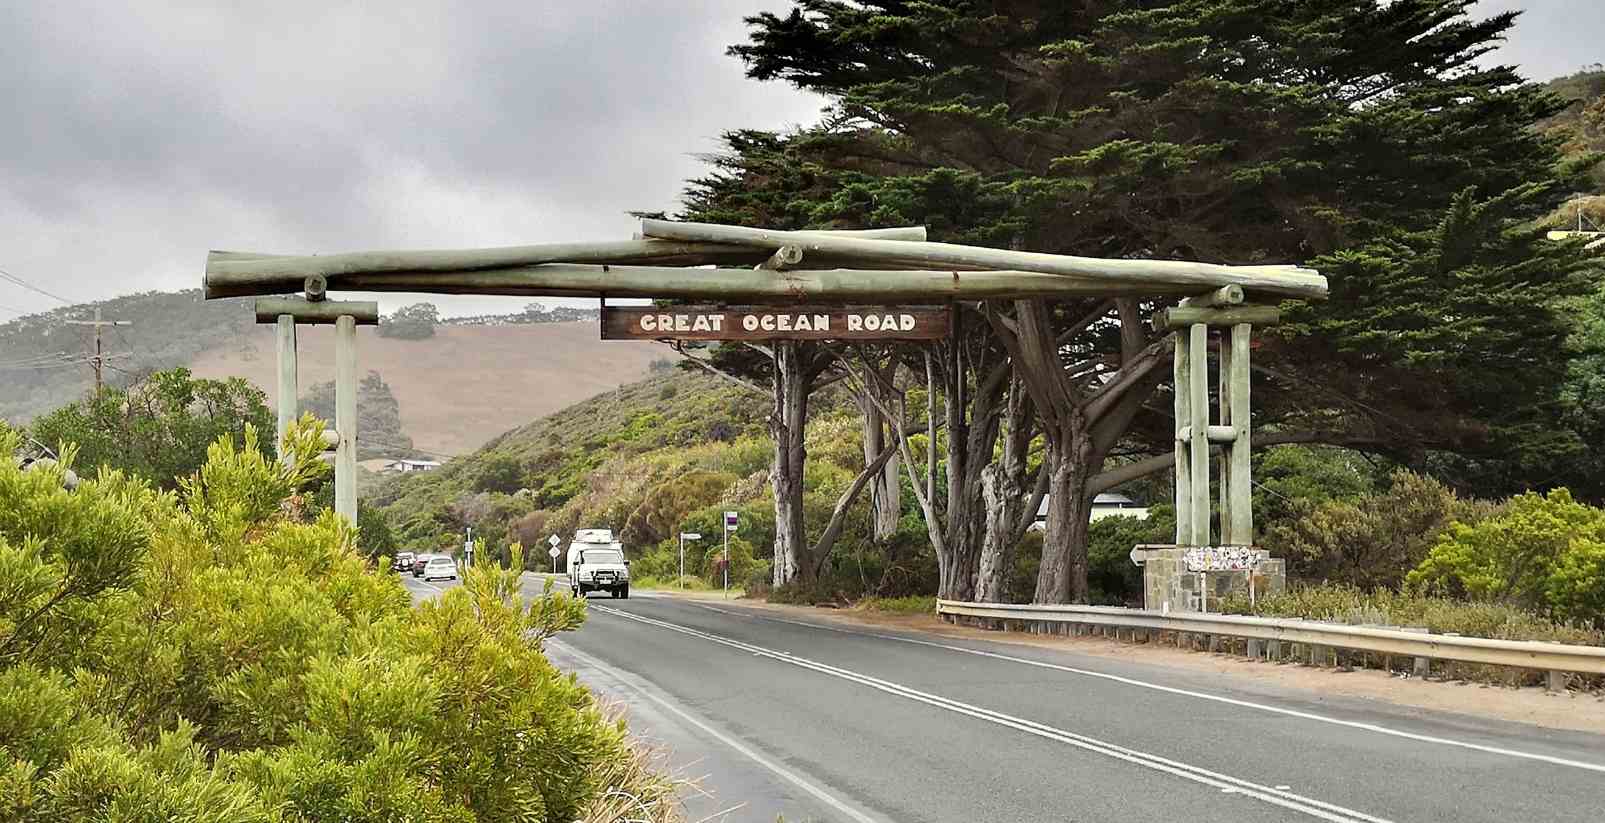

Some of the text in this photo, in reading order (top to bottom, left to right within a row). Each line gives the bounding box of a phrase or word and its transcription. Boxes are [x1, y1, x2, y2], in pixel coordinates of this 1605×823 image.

[640, 314, 916, 332] GREAT OCEAN ROAD
